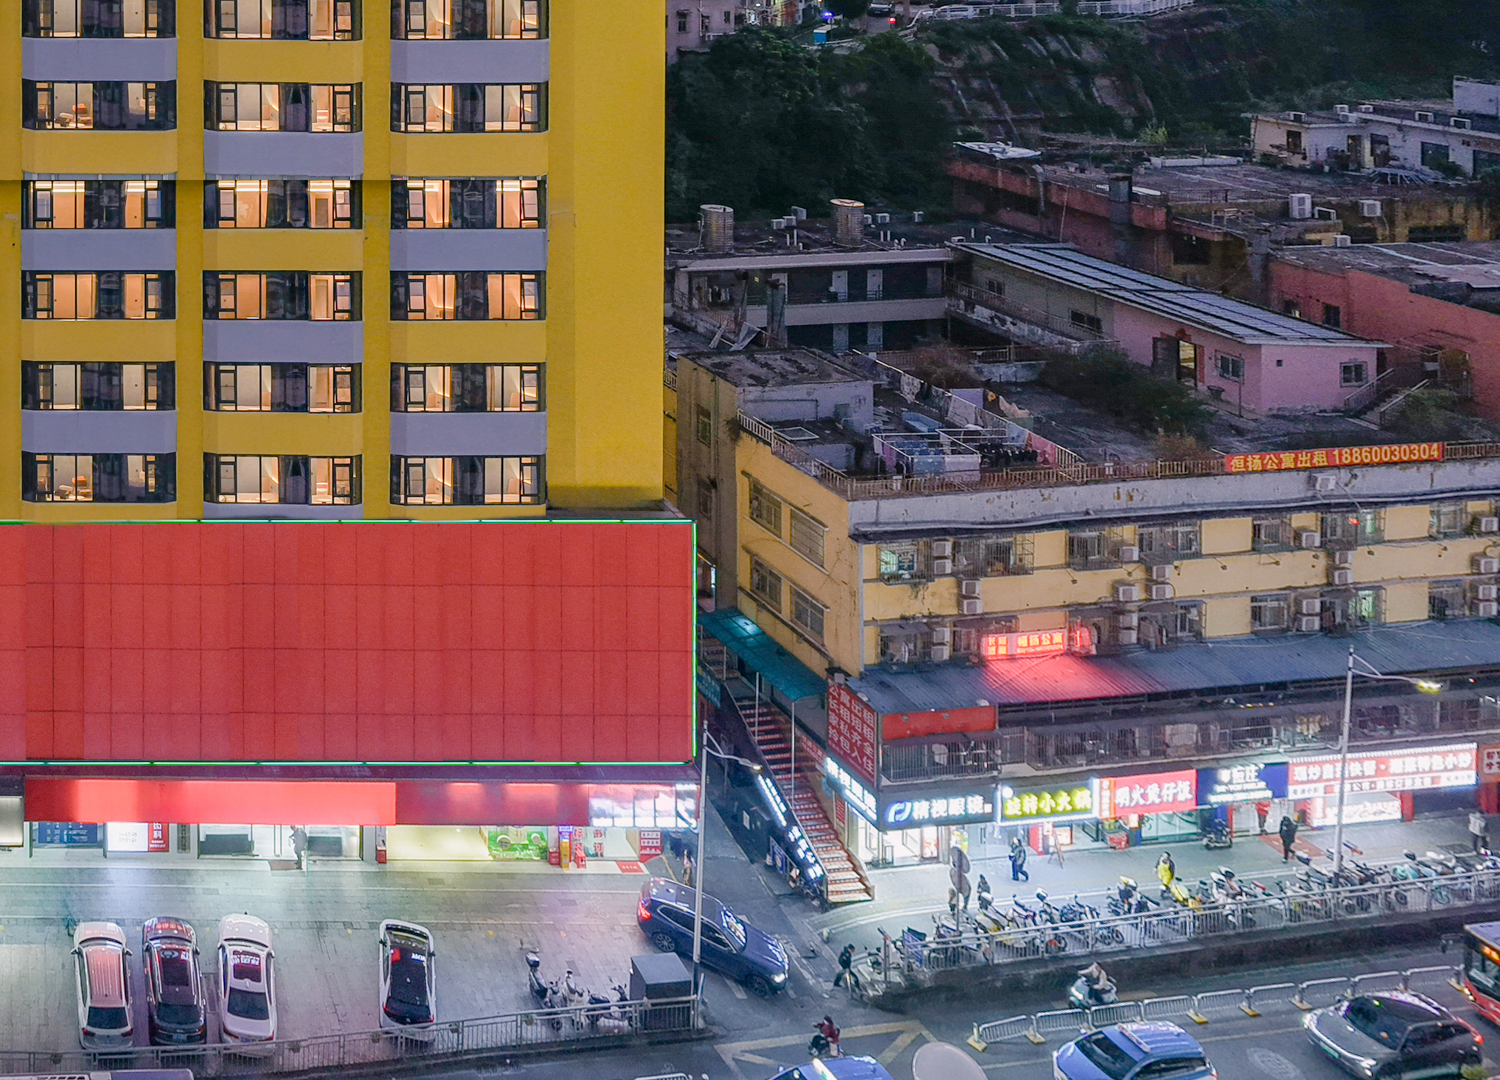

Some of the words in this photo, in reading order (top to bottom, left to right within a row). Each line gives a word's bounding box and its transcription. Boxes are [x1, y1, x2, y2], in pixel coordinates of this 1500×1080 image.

[1332, 444, 1439, 465] 18860030304
[829, 695, 874, 743] 长租短租
[829, 711, 874, 759] 家私齐全
[828, 726, 874, 775] 拎包入住
